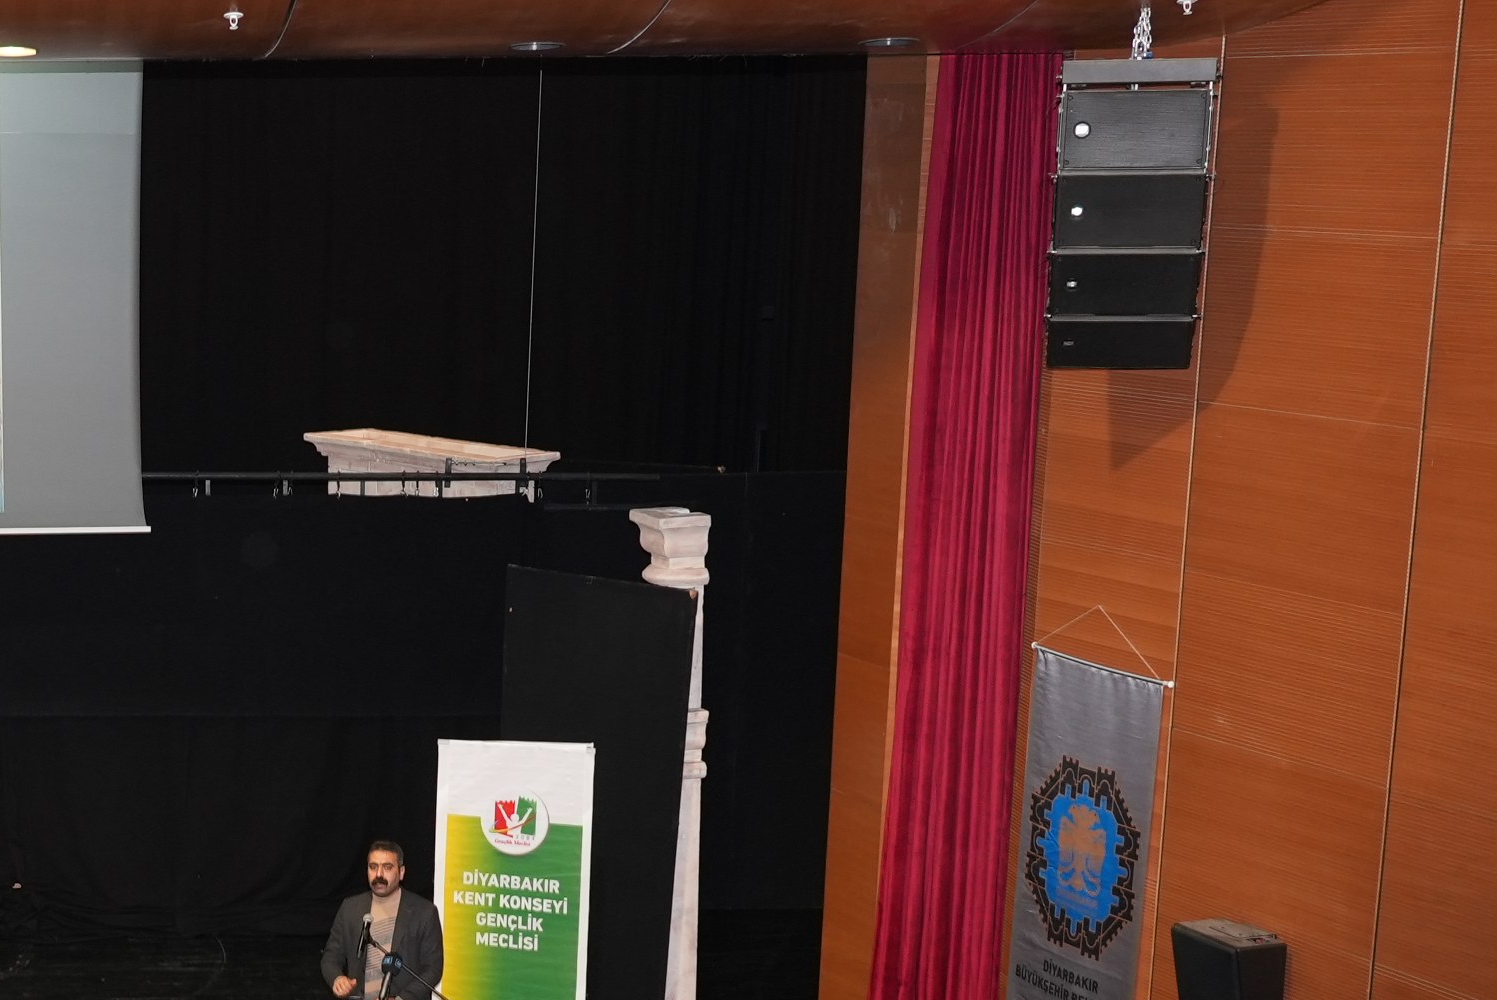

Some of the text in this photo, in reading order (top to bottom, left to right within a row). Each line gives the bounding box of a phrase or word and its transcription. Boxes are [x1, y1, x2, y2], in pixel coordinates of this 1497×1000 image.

[463, 869, 560, 894] DİYARBAKIR
[453, 890, 568, 914] KENT KONSEYİ
[476, 912, 543, 932] GENÇLİK
[476, 932, 539, 951] MECLİSİ
[1043, 958, 1099, 994] DİYARBAKIR
